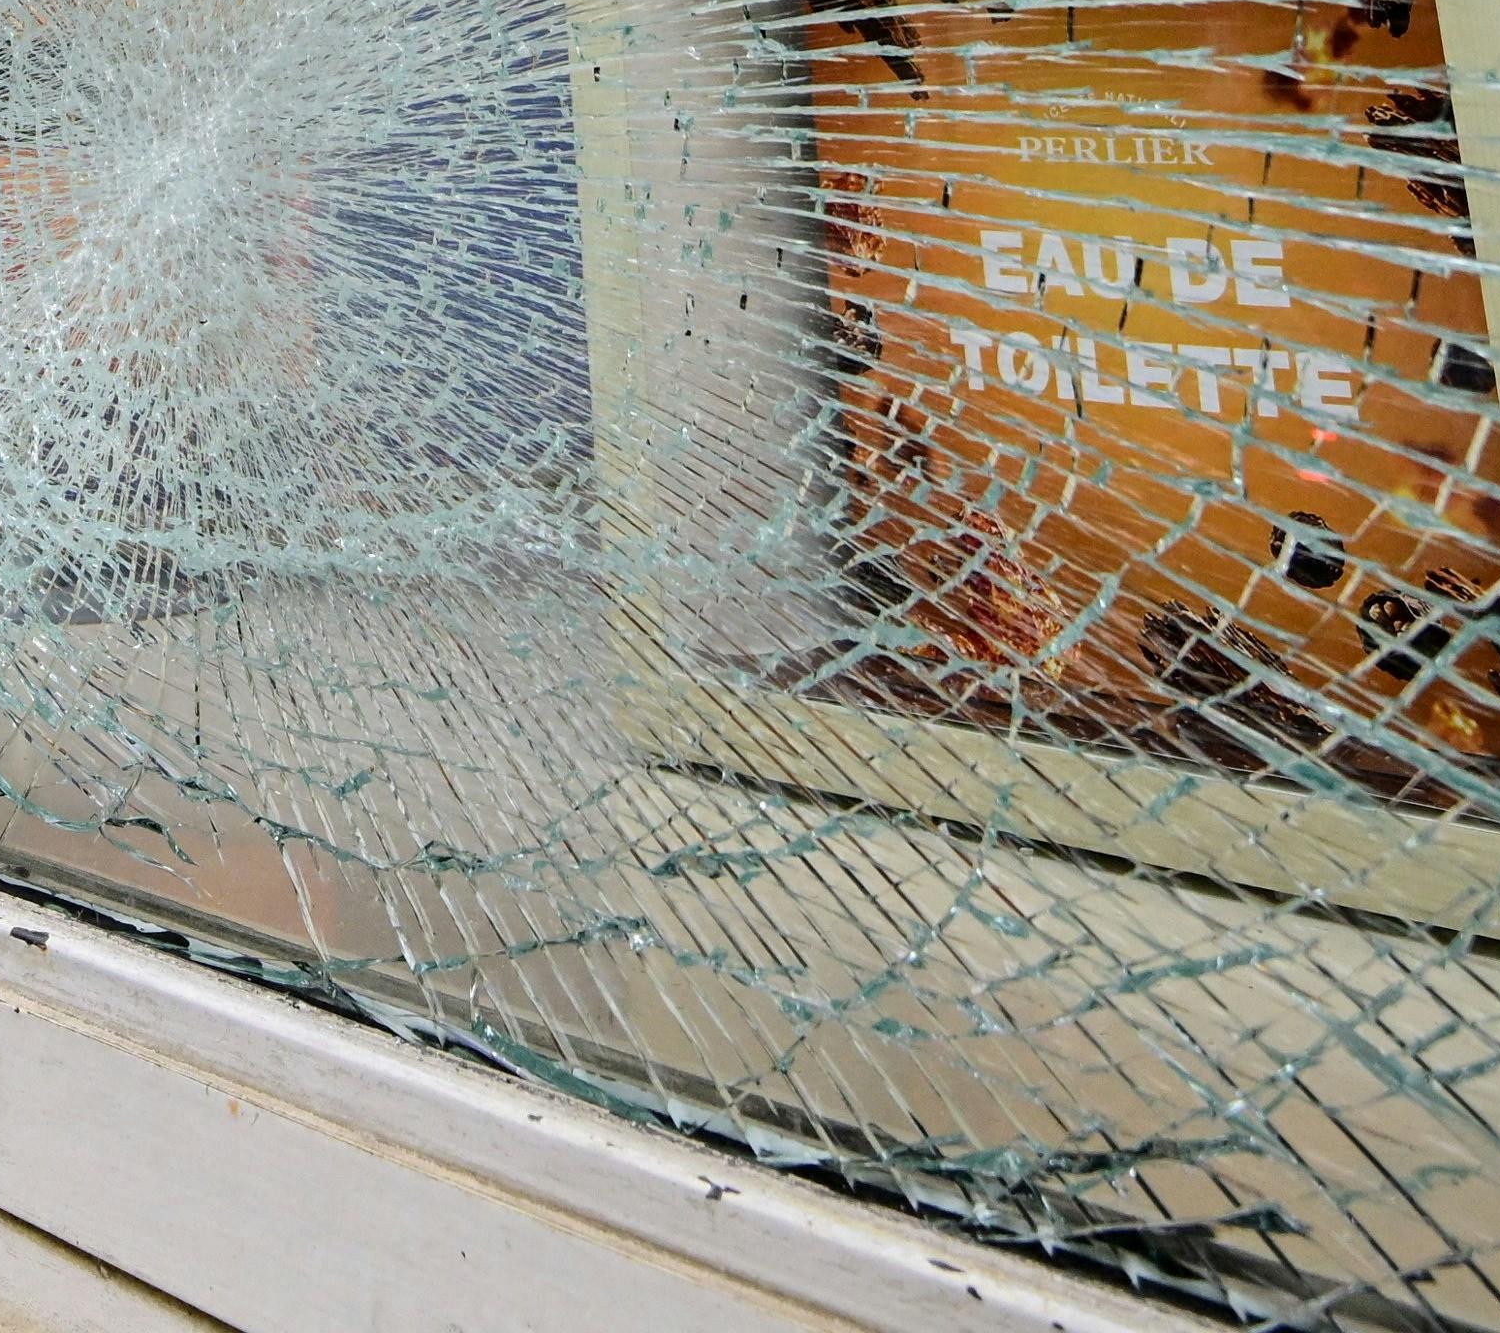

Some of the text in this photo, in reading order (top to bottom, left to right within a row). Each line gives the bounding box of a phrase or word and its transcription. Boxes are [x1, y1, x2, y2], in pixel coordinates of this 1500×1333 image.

[1016, 135, 1216, 166] PERLIER
[977, 229, 1292, 311] EAU DE
[947, 330, 1364, 423] TOILETTE
